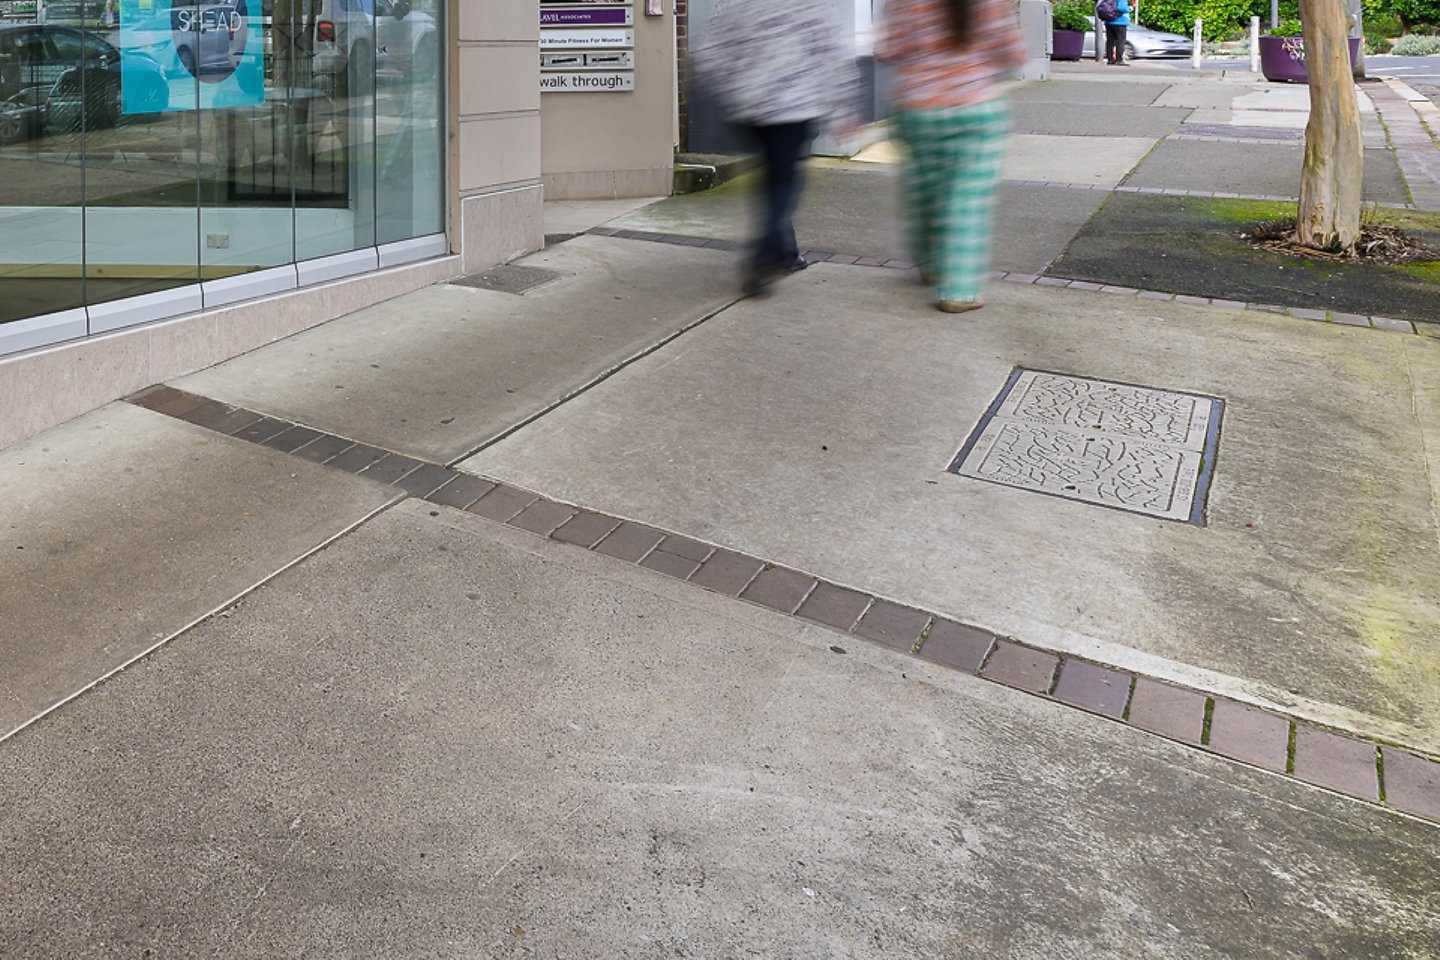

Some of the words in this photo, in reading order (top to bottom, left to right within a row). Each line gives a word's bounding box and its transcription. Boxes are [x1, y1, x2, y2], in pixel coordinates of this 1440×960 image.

[177, 10, 242, 32] SHEAD
[539, 75, 568, 87] walk
[572, 74, 623, 89] through
